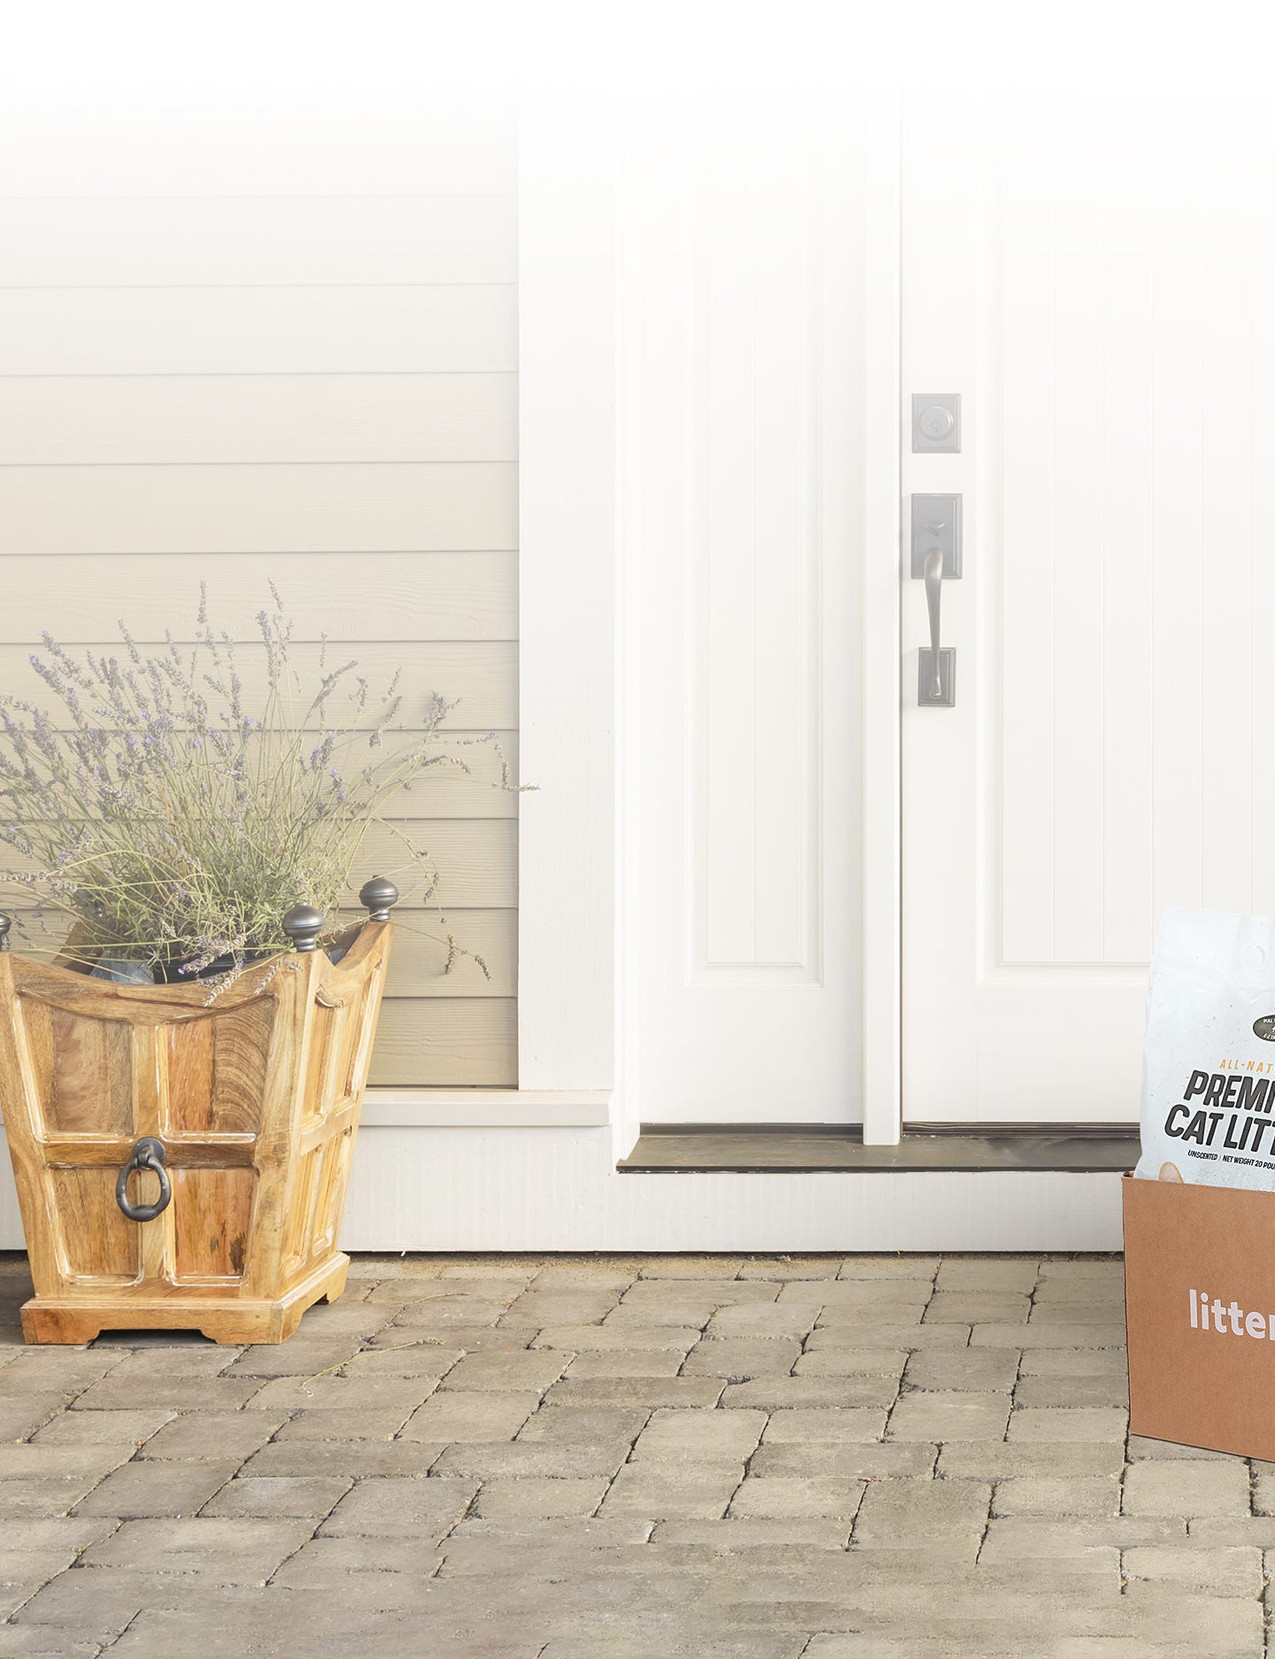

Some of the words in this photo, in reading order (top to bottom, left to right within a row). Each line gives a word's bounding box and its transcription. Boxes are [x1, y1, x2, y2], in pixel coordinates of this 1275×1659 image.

[1164, 1104, 1224, 1147] CAT
[1187, 1149, 1218, 1161] UNSCENTED
[1222, 1154, 1233, 1163] NET
[1234, 1156, 1254, 1166] WEIGHT
[1254, 1160, 1262, 1168] 20
